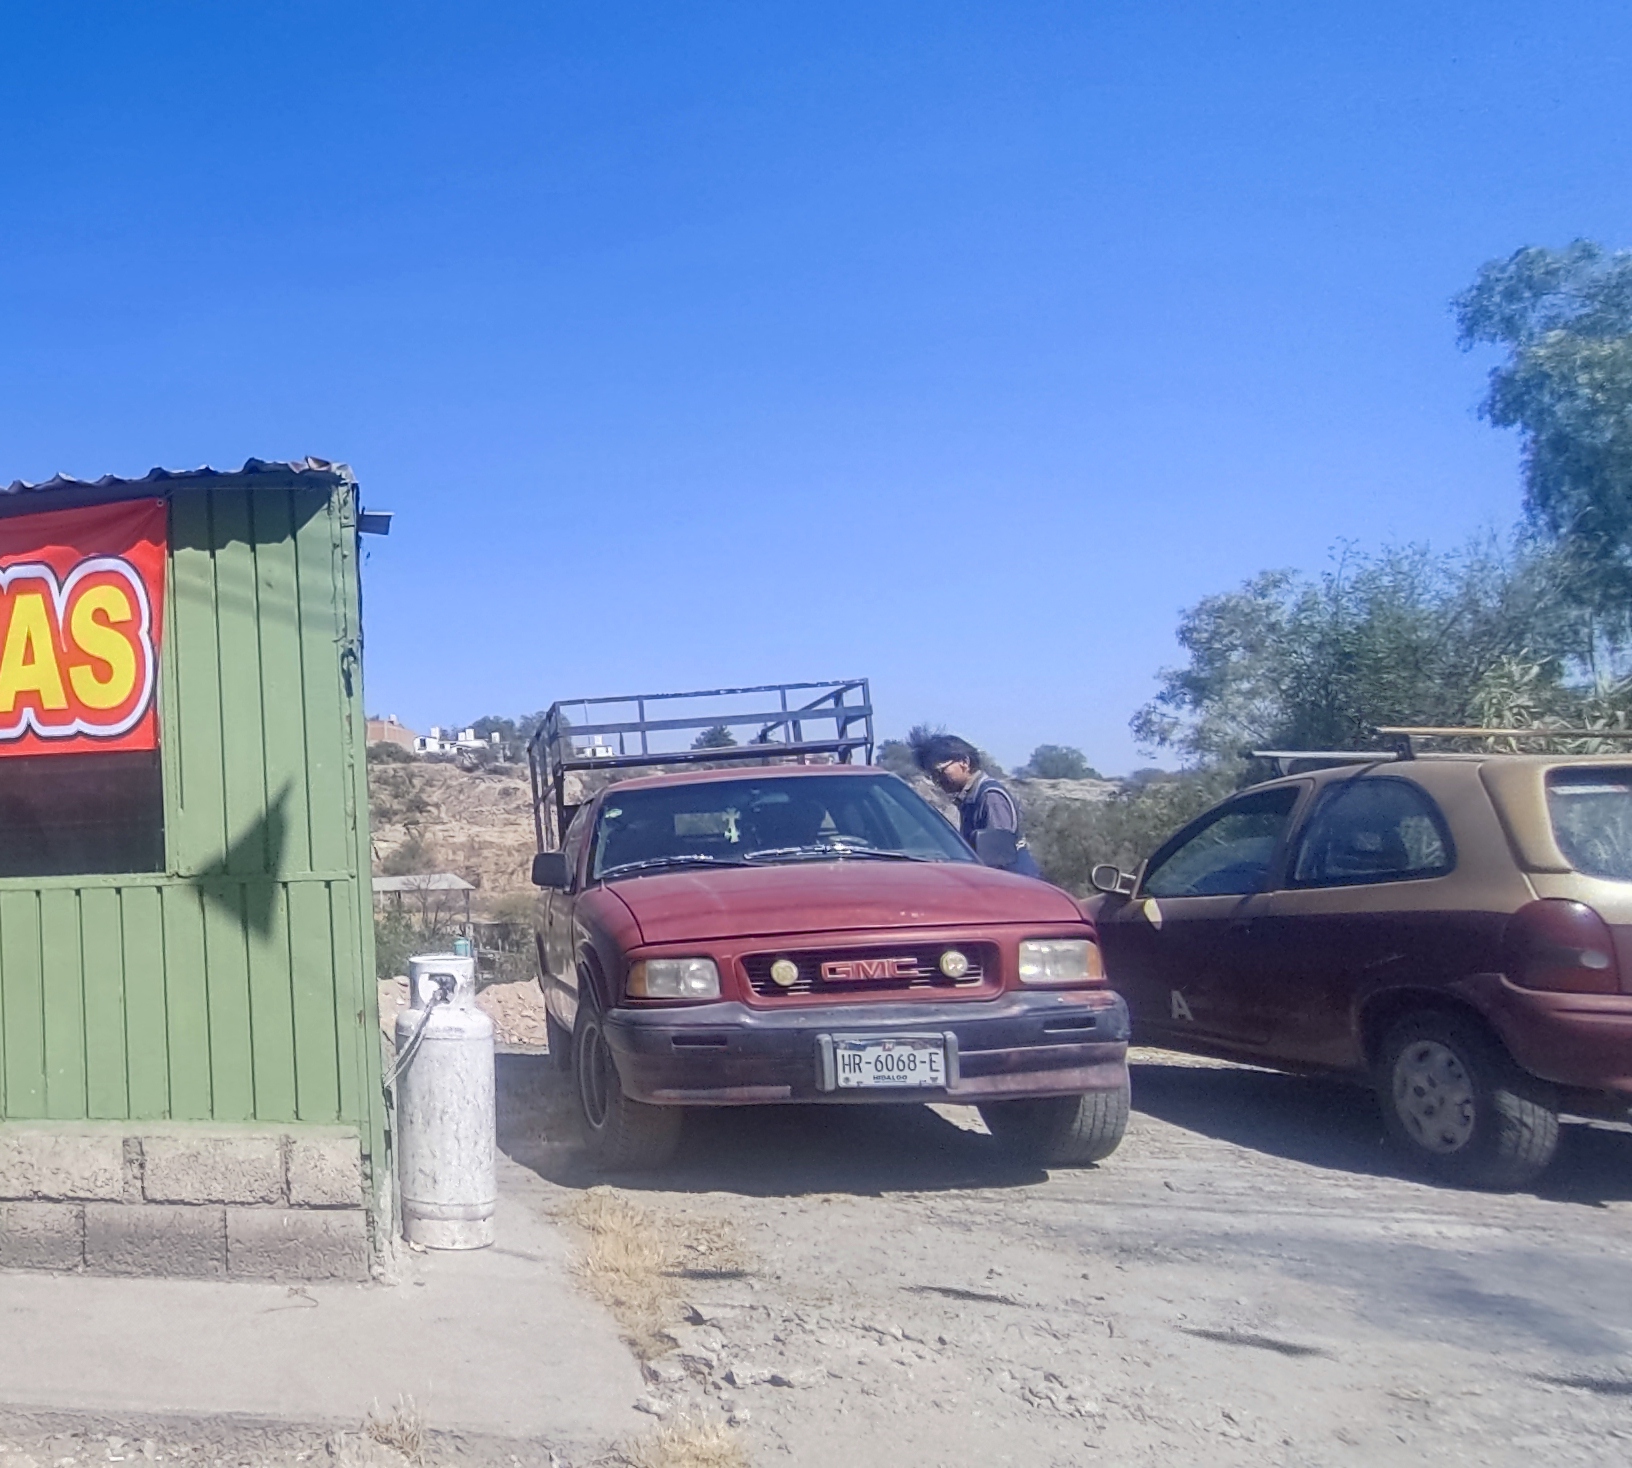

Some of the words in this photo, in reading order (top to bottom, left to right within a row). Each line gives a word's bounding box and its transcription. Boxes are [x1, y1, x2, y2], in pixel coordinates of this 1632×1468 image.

[821, 957, 919, 981] GMC
[1170, 989, 1194, 1021] A
[841, 1052, 941, 1074] HR-6068-E
